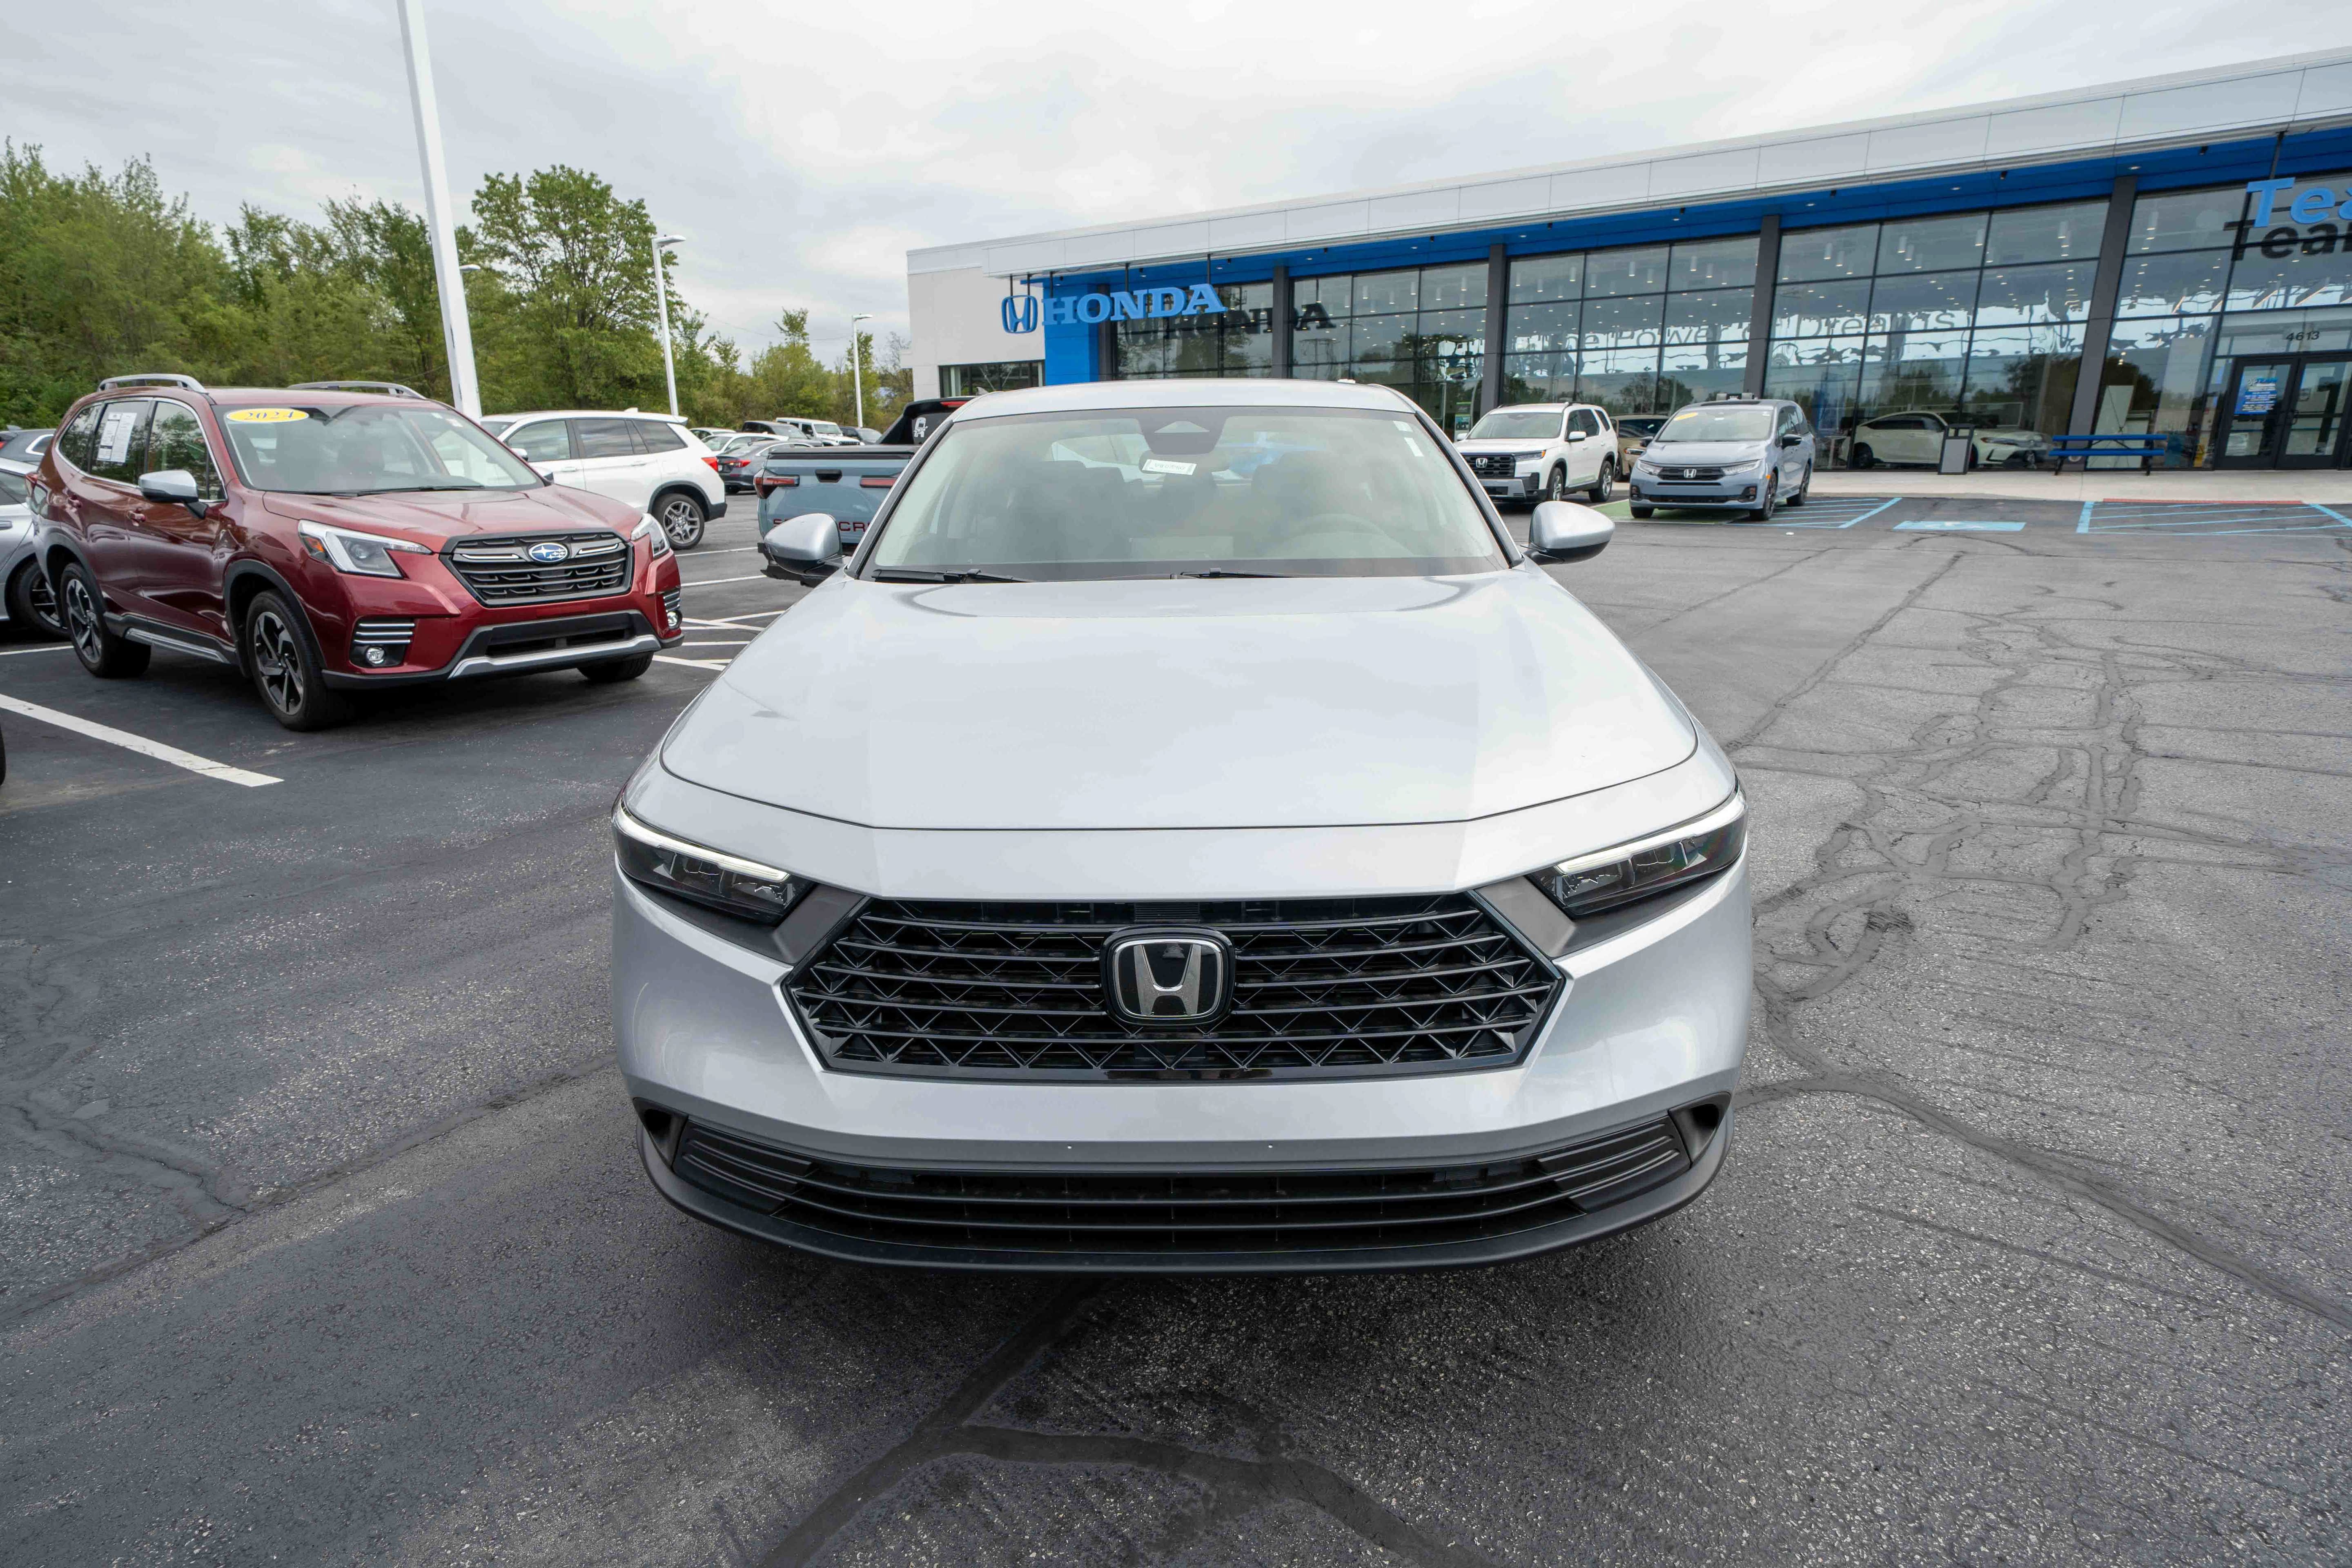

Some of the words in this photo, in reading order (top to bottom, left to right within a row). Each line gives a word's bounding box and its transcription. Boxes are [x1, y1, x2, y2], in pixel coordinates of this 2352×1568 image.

[2223, 219, 2352, 261] Tea
[1042, 283, 1228, 326] HONDA
[2286, 331, 2320, 341] 4613
[244, 410, 295, 420] 2024
[838, 521, 871, 532] CR
